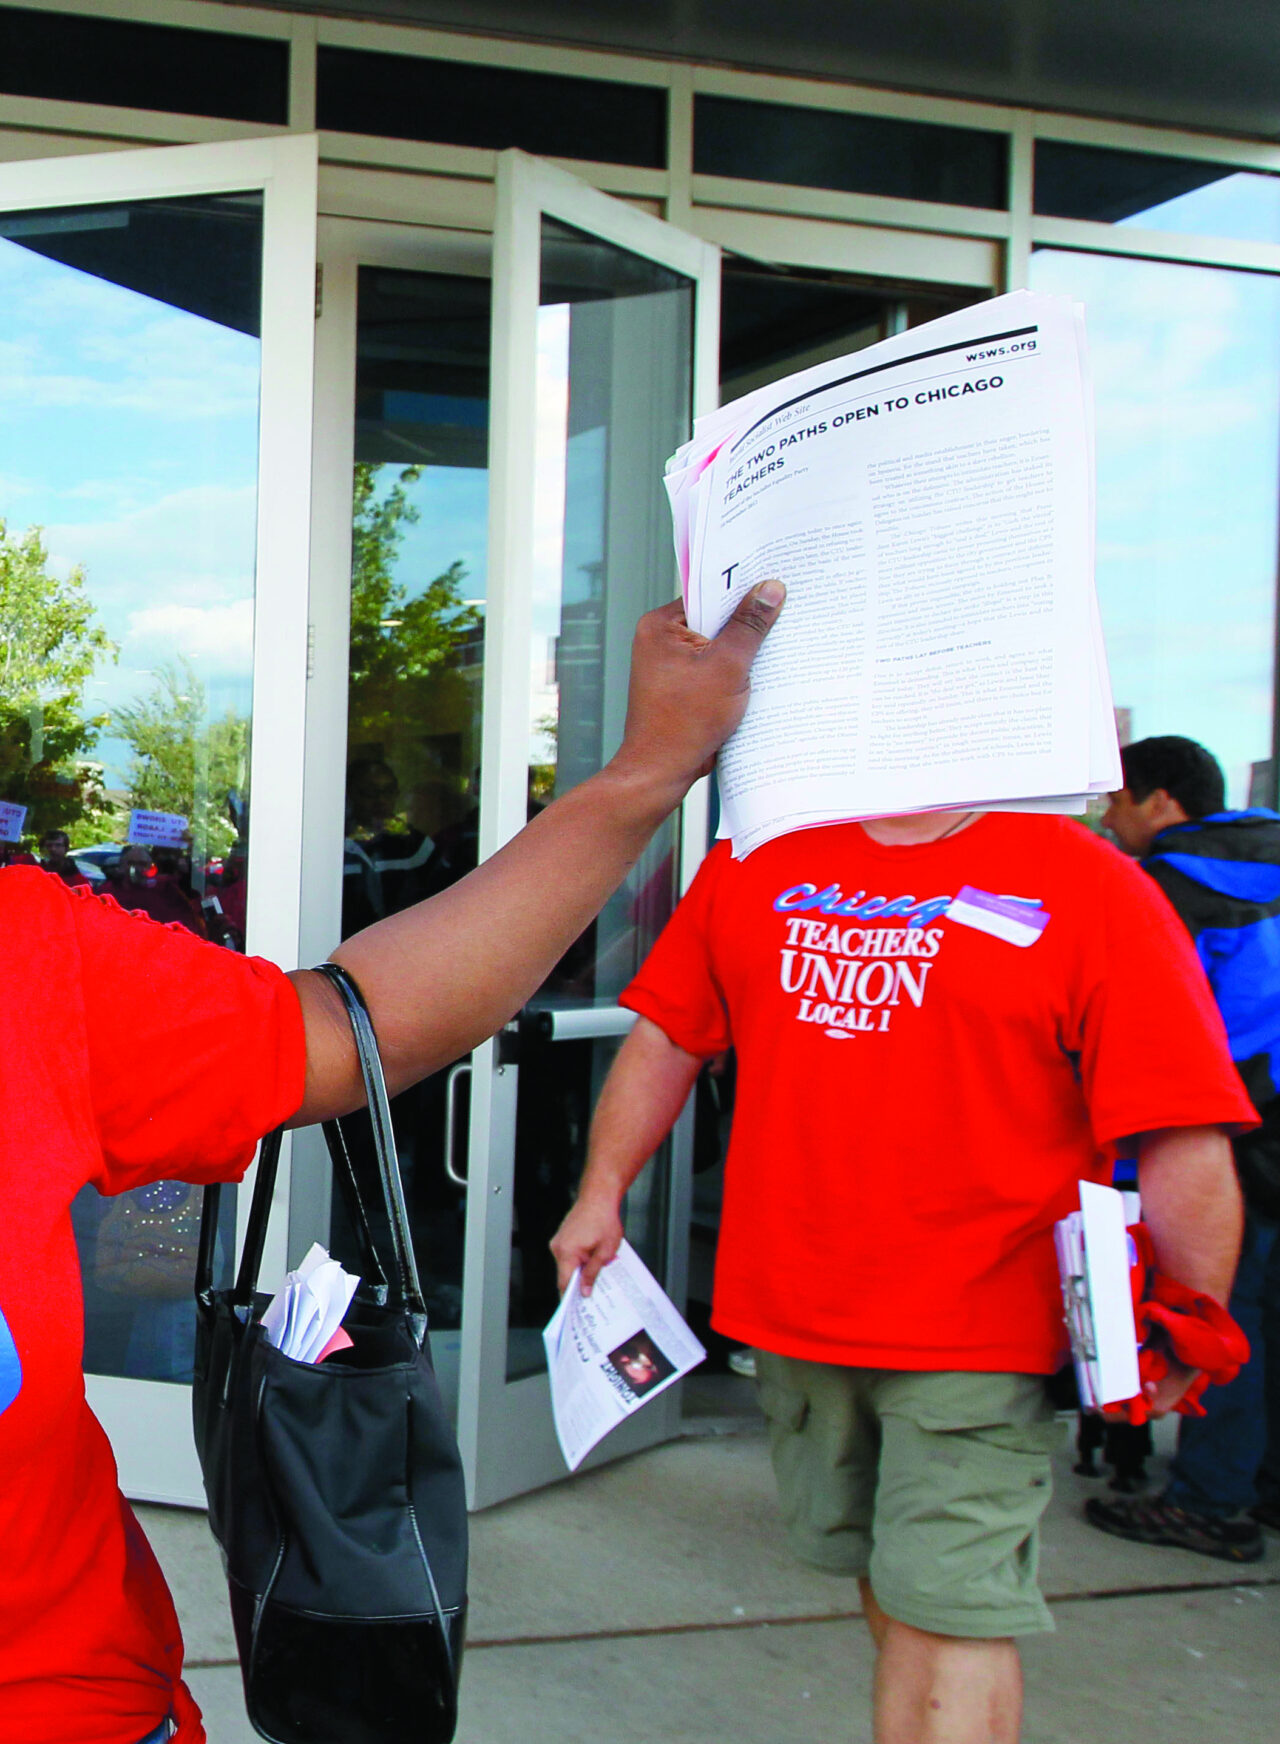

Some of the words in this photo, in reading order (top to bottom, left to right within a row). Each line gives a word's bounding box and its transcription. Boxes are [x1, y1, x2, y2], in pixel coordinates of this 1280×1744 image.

[966, 338, 1038, 362] wsws.org
[726, 465, 744, 489] THE
[747, 445, 776, 470] TWO
[779, 421, 828, 451] PATHS
[831, 404, 880, 429] OPEN
[883, 396, 910, 414] TO
[914, 375, 1005, 405] CHICAGO
[775, 411, 793, 427] Web
[794, 403, 812, 417] Site
[723, 457, 786, 505] TEACHERS
[956, 639, 992, 651] TEACHERS
[773, 883, 1044, 929] Chicag
[785, 917, 945, 958] TEACHERS
[779, 949, 933, 1008] UNION
[796, 998, 875, 1032] LOCAL
[878, 1009, 891, 1033] 1
